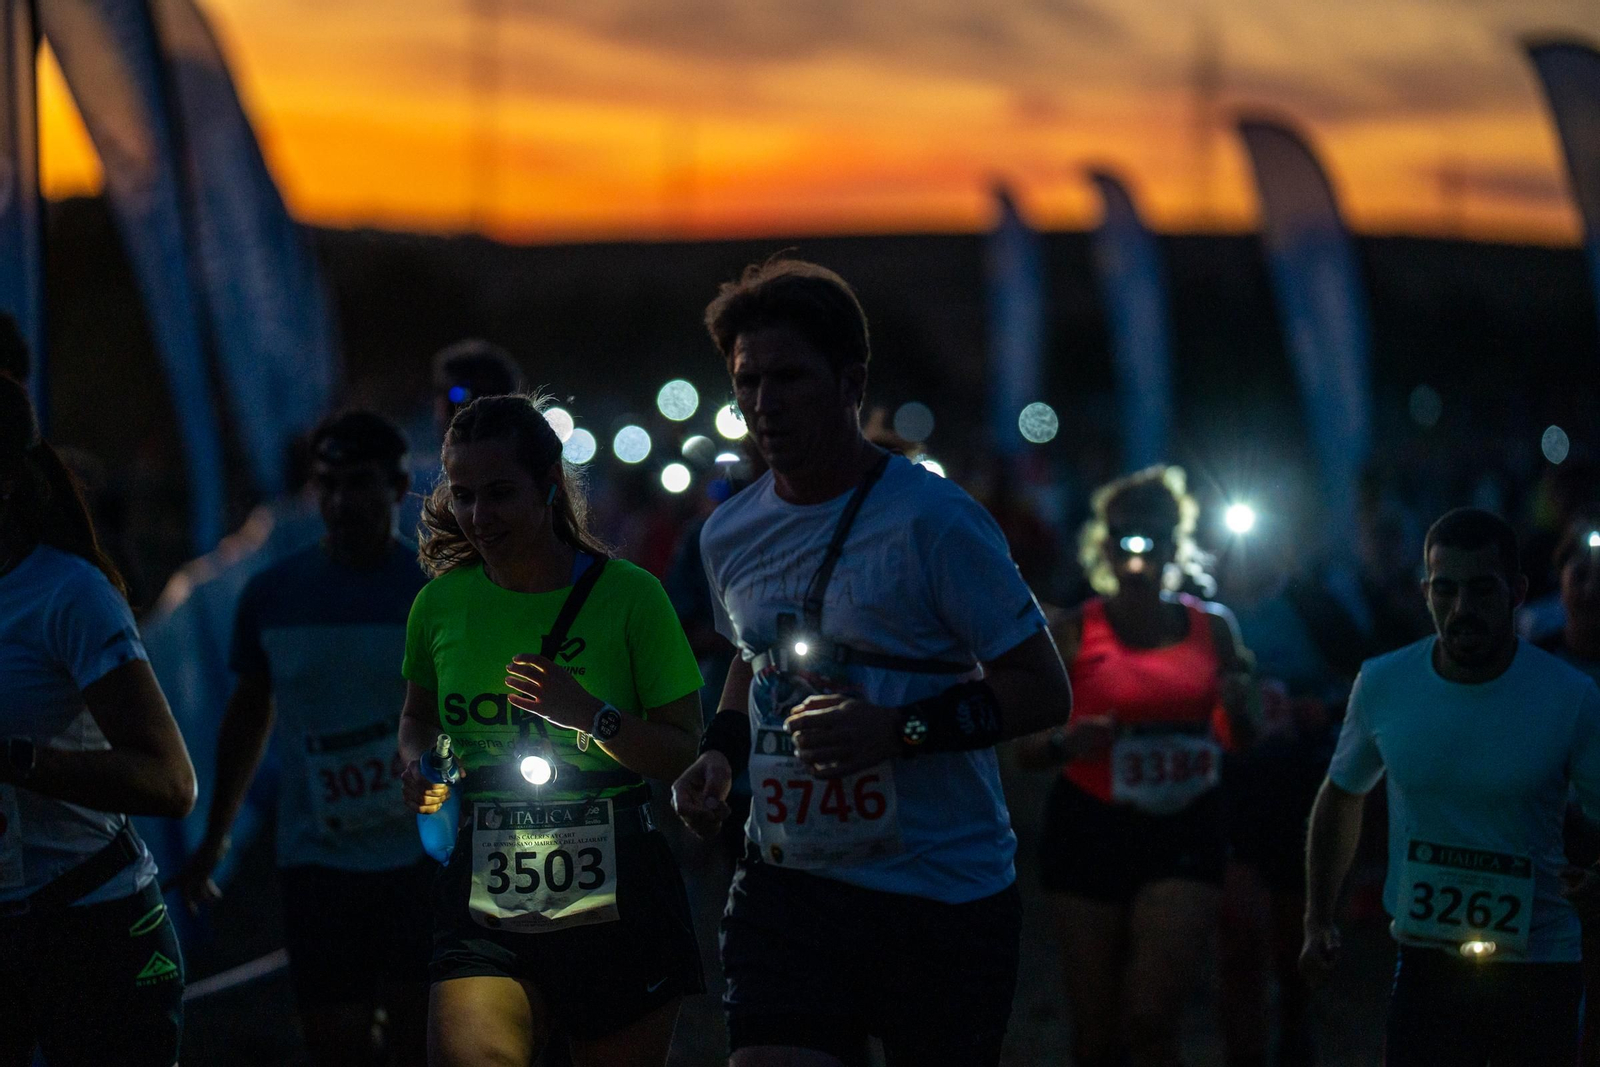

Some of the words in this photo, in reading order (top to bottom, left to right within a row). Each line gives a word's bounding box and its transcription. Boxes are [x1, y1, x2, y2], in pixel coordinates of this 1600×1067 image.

[509, 809, 573, 825] ITALICA
[762, 775, 886, 824] 3746
[487, 847, 605, 894] 3503
[1440, 849, 1500, 869] ITALICA
[1409, 882, 1521, 933] 3262
